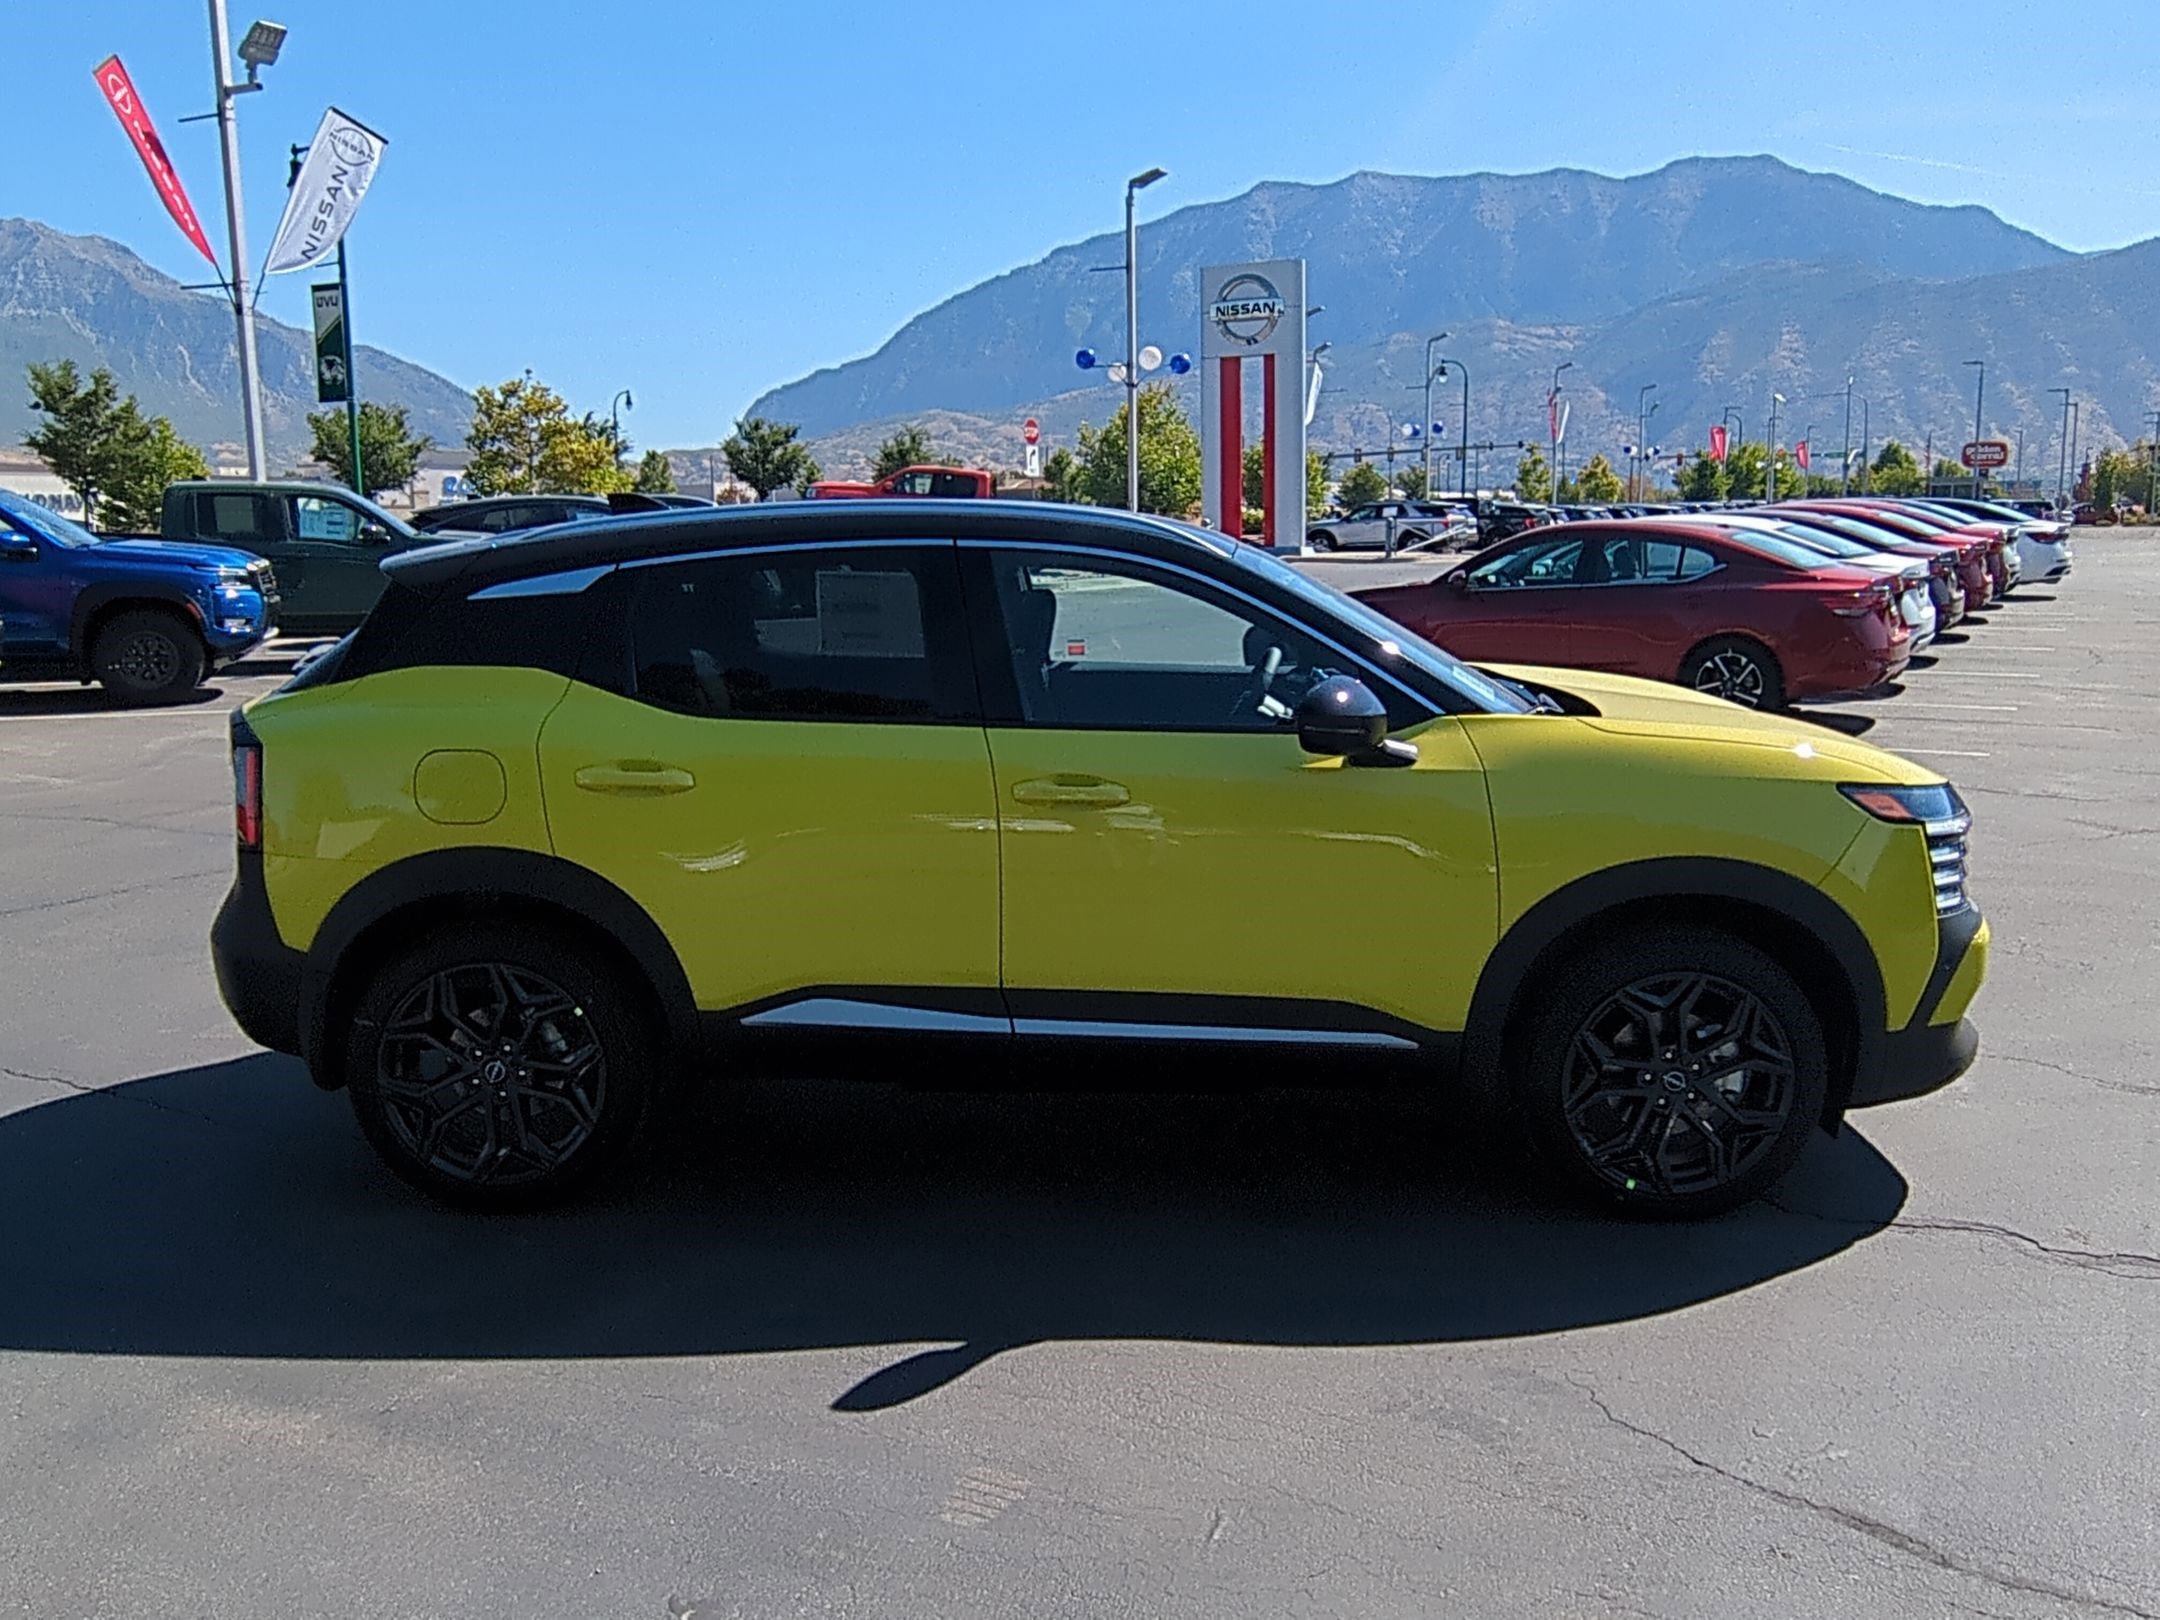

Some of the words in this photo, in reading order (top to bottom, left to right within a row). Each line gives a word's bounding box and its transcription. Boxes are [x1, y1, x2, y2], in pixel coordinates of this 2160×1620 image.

[301, 165, 348, 260] NISSAN
[316, 295, 339, 308] UVU
[1216, 301, 1275, 318] NISSAN
